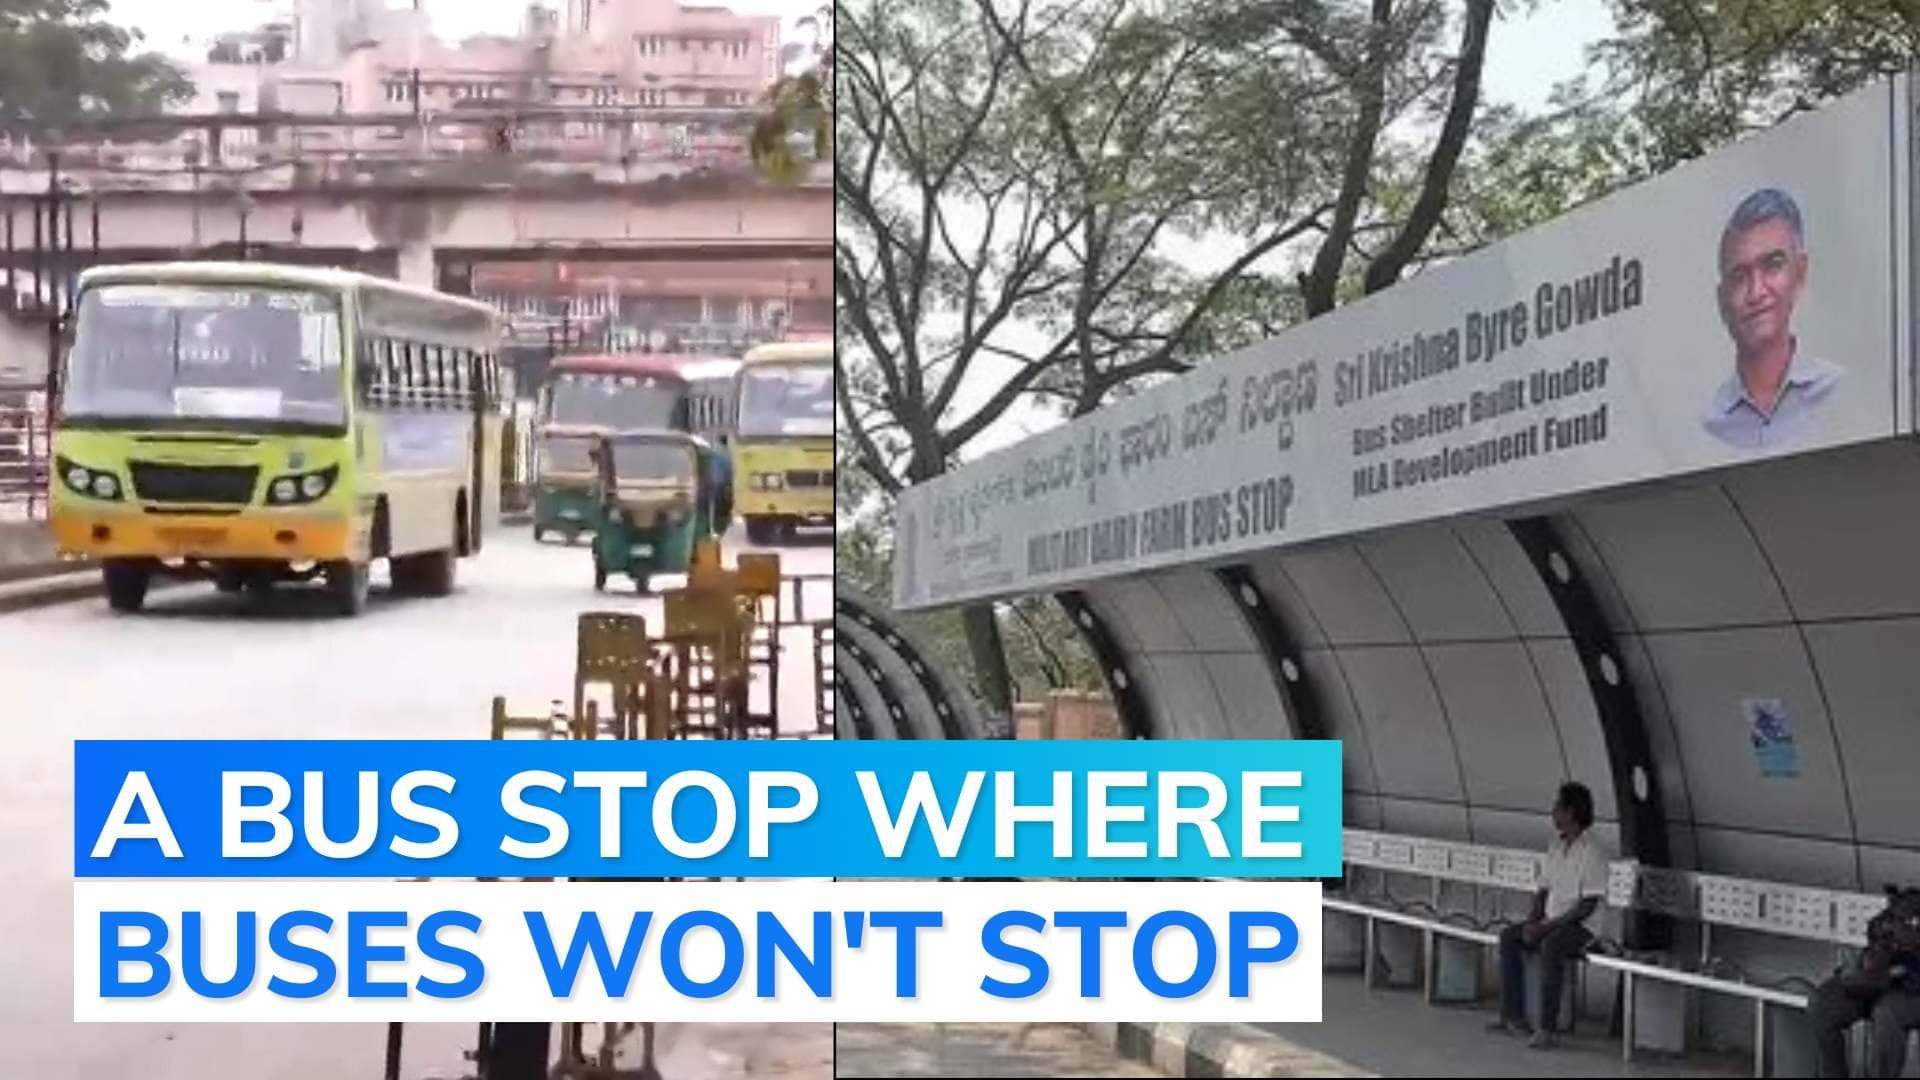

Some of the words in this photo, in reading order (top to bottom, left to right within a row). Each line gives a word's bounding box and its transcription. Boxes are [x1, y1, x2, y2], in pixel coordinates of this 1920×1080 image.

[1334, 353, 1365, 407] Sri
[1368, 327, 1460, 397] Krishna
[1465, 301, 1527, 363] Byre
[1535, 256, 1644, 340] Gowda
[1352, 424, 1386, 456] Bus
[1391, 401, 1466, 446] Shelter
[1470, 379, 1525, 423] Built
[1530, 356, 1610, 405] Under
[1353, 462, 1388, 499] MLA
[1393, 424, 1538, 490] Development
[1544, 403, 1609, 453] Fund
[1192, 489, 1231, 546] BUS
[1236, 474, 1295, 538] STOP
